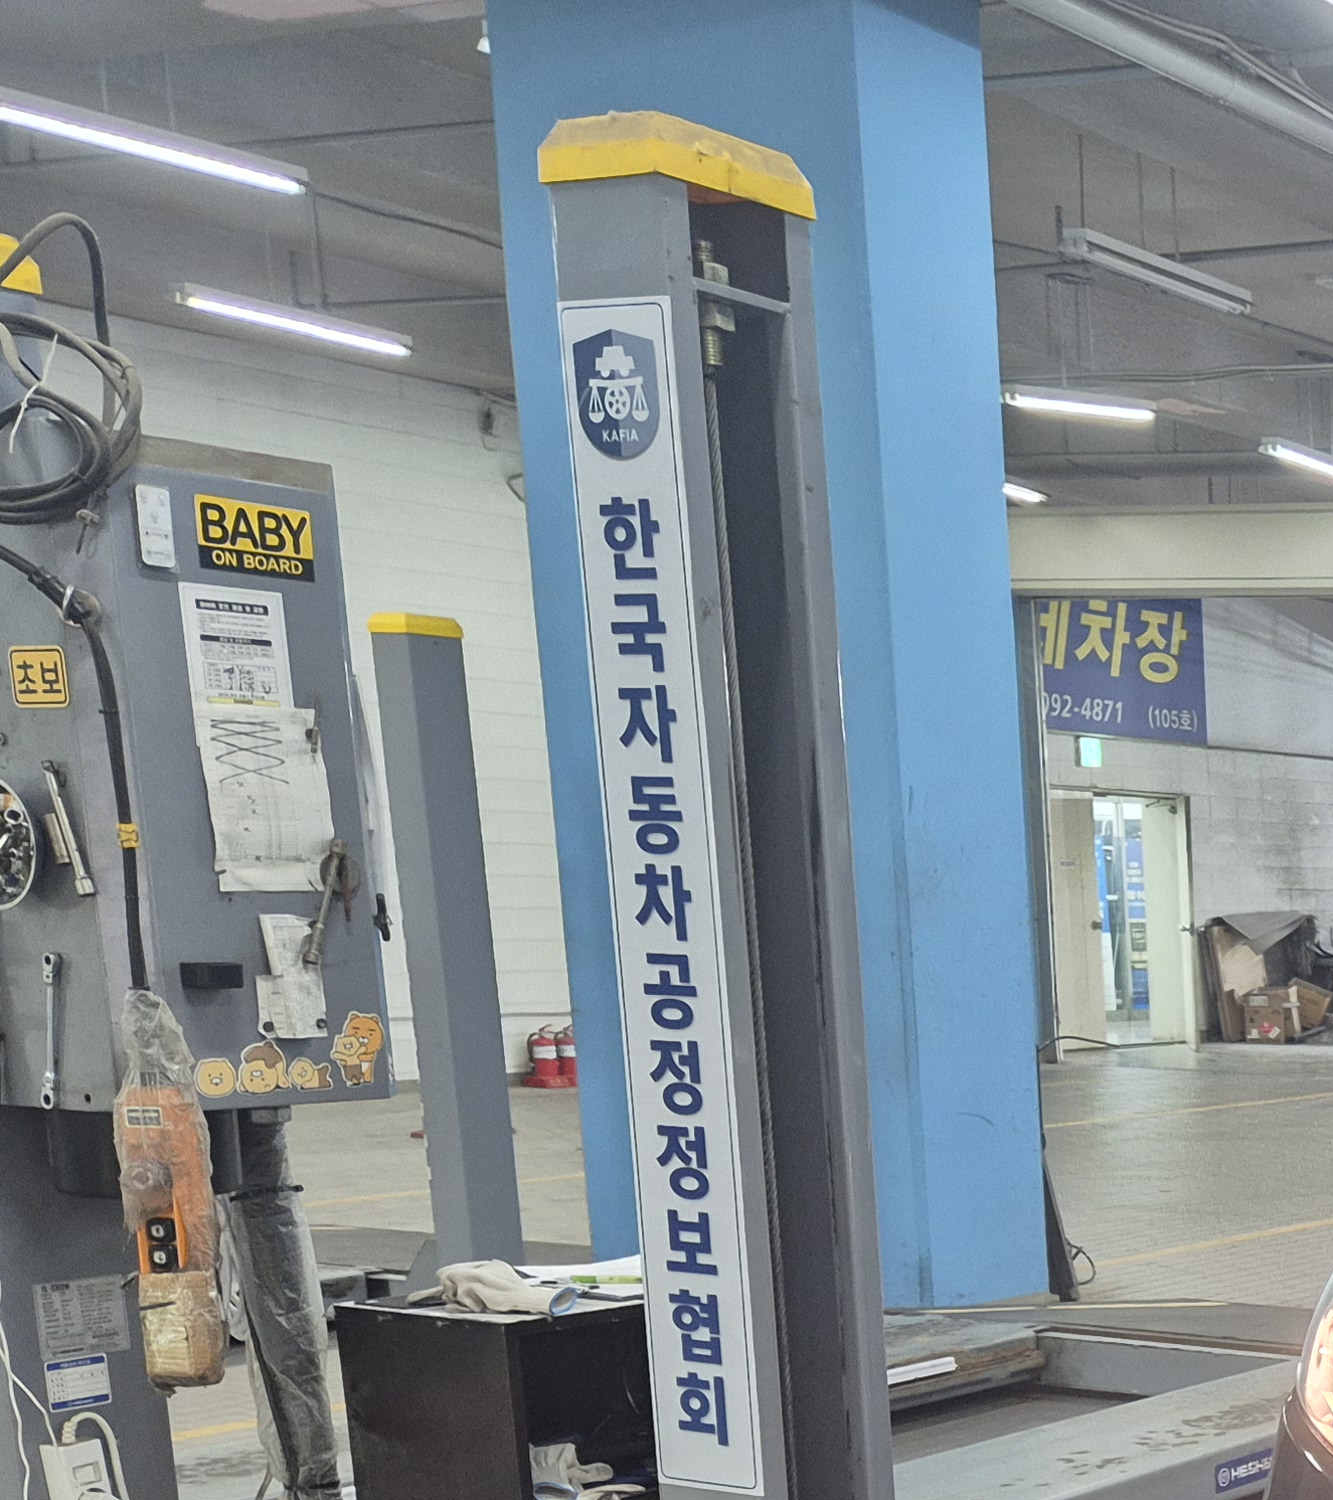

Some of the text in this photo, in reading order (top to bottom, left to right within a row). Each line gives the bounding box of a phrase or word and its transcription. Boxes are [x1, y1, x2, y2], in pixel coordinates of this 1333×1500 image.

[602, 428, 639, 443] KAFIA
[199, 501, 308, 556] BABY
[211, 549, 303, 575] ON BOARD
[16, 659, 62, 694] 초보
[1148, 704, 1197, 733] (105호)
[600, 496, 729, 1446] 한국자동차공정정보협회
